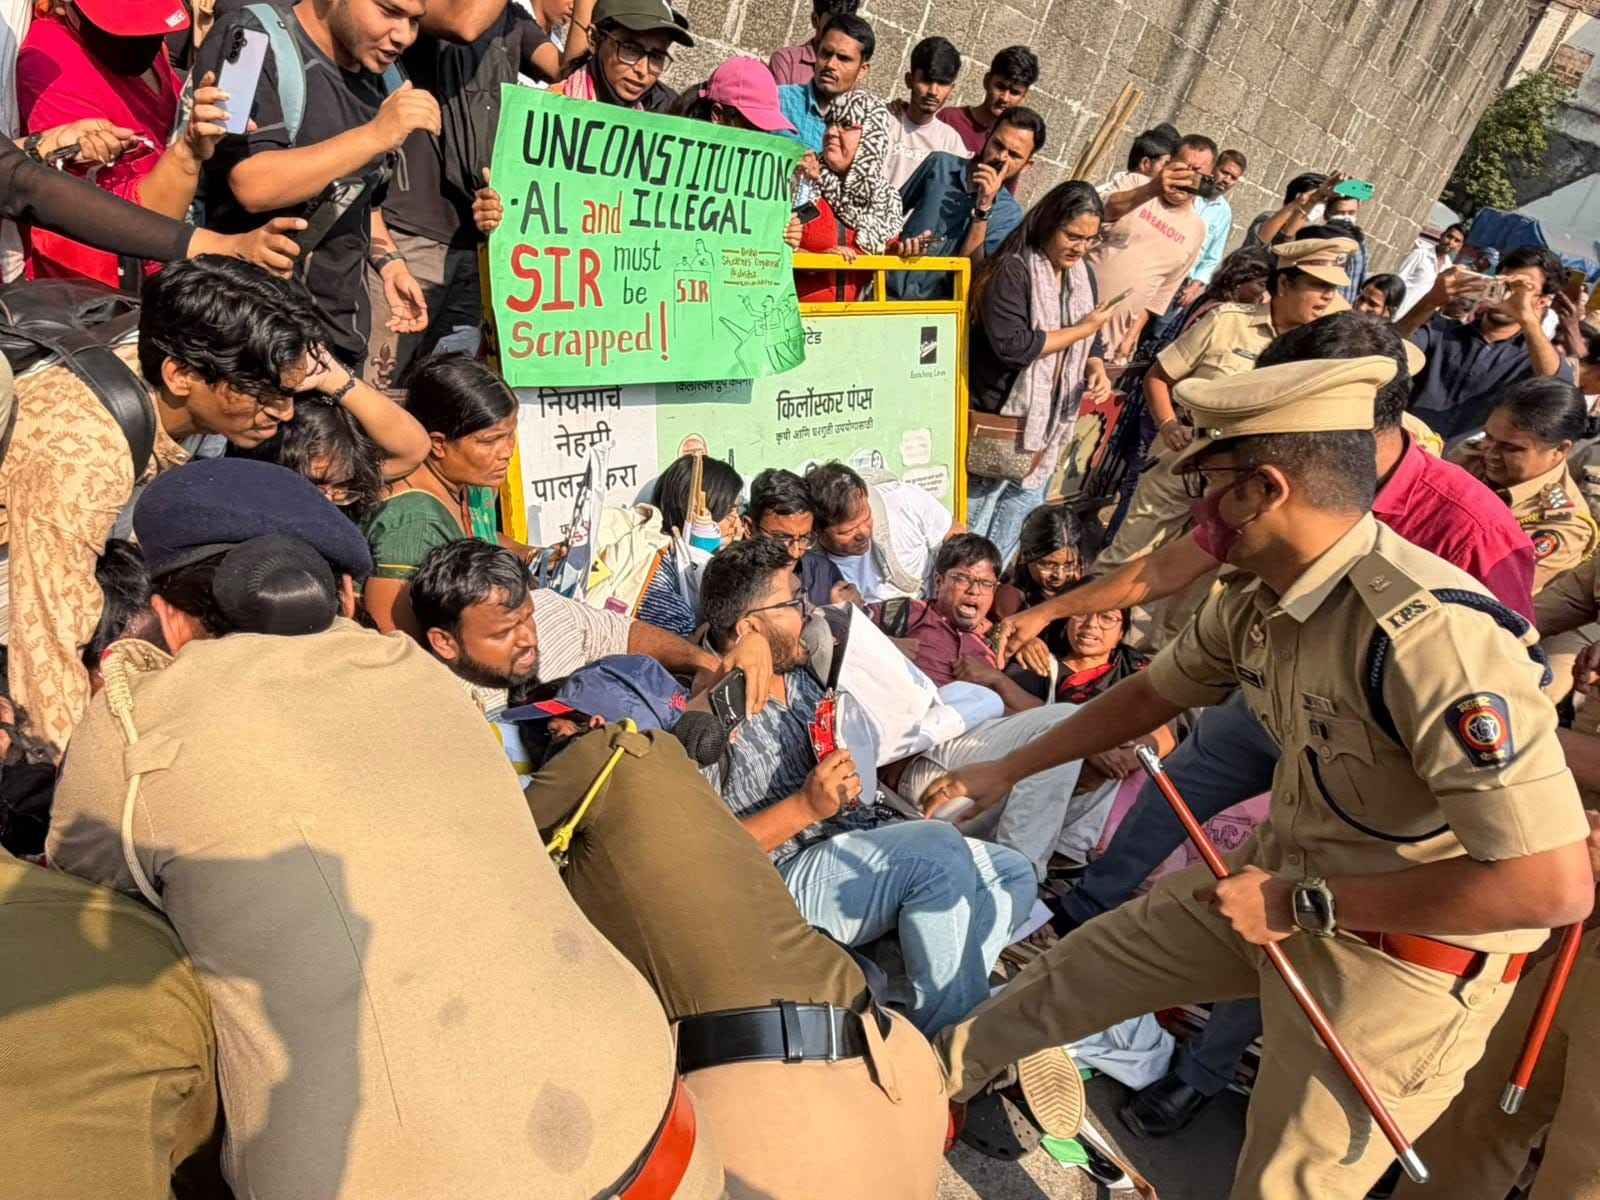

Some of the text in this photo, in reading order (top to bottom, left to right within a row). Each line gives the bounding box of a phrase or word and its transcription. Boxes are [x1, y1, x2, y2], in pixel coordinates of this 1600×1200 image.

[581, 191, 623, 236] and
[628, 188, 752, 235] ILLEGAL
[613, 239, 662, 272] must
[505, 243, 603, 313] SIR
[622, 276, 648, 305] be
[676, 278, 710, 304] SIR
[507, 301, 669, 367] Scrapped!
[538, 384, 623, 418] नियमाच
